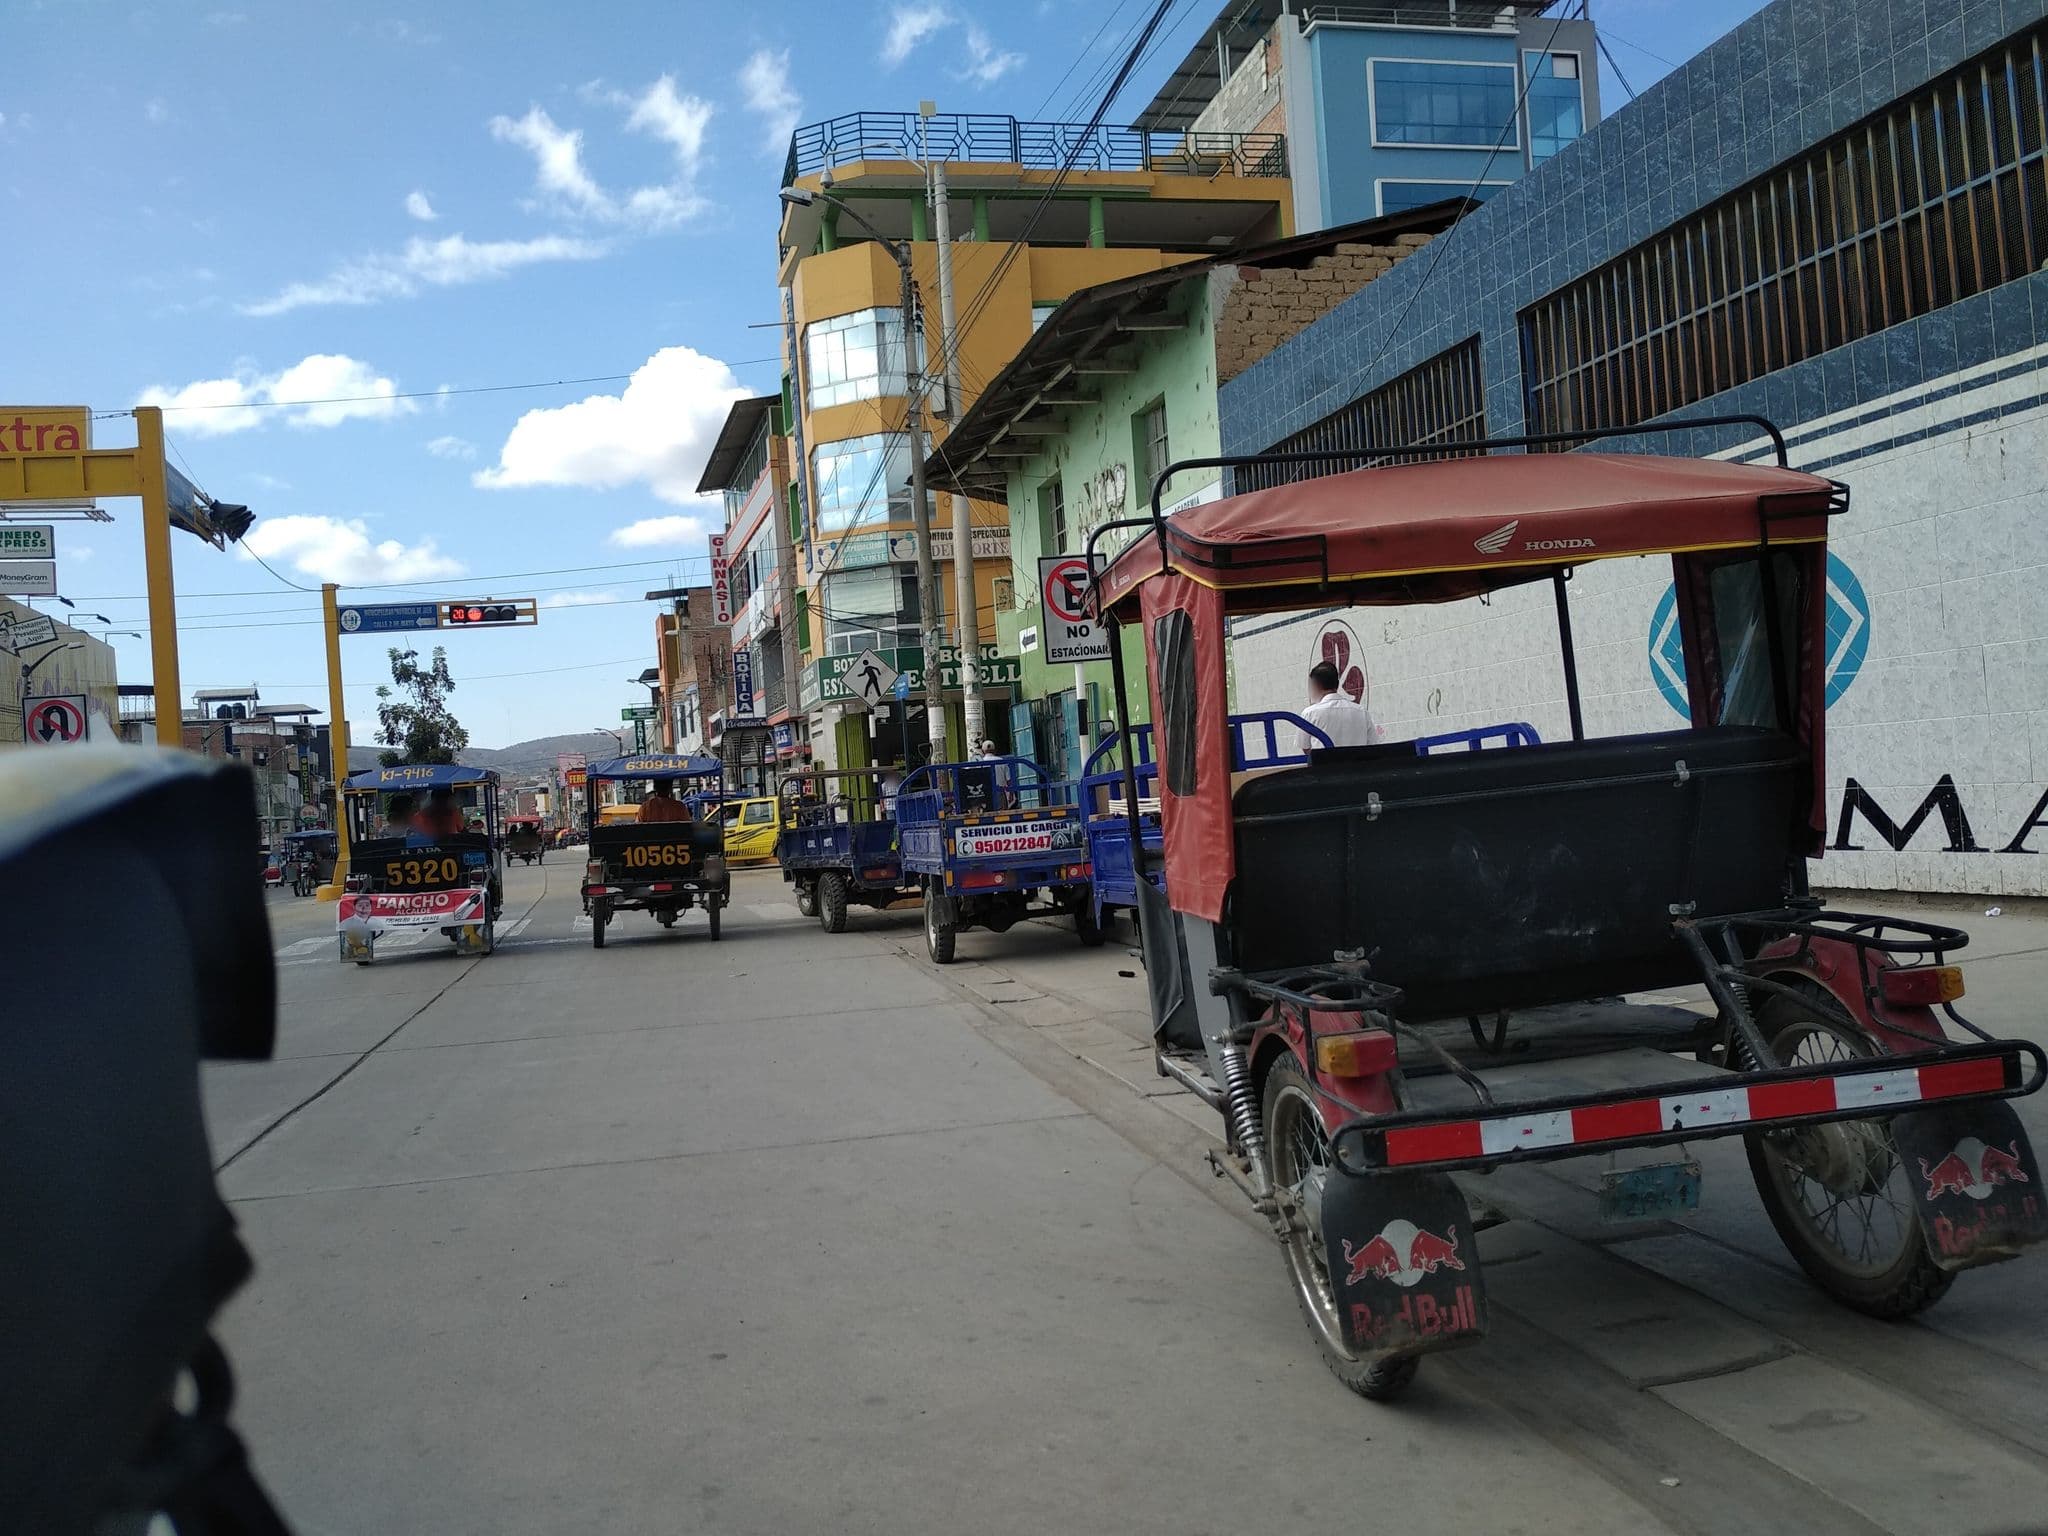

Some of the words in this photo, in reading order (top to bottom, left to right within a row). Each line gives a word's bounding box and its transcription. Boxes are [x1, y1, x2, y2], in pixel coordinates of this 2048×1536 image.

[1525, 538, 1596, 551] HONDA
[712, 537, 730, 623] GIMNASIO
[1066, 625, 1090, 638] NO
[736, 653, 752, 711] BOTICA
[625, 760, 688, 771] 6309-LM
[961, 826, 1012, 838] SERVICIO
[1015, 824, 1028, 834] DE
[1030, 821, 1068, 833] CARGA
[975, 835, 1052, 853] 950212847
[623, 845, 691, 868] 10565
[386, 858, 458, 886] 5320
[376, 893, 449, 909] PANCHO
[396, 907, 431, 915] ALCALDE
